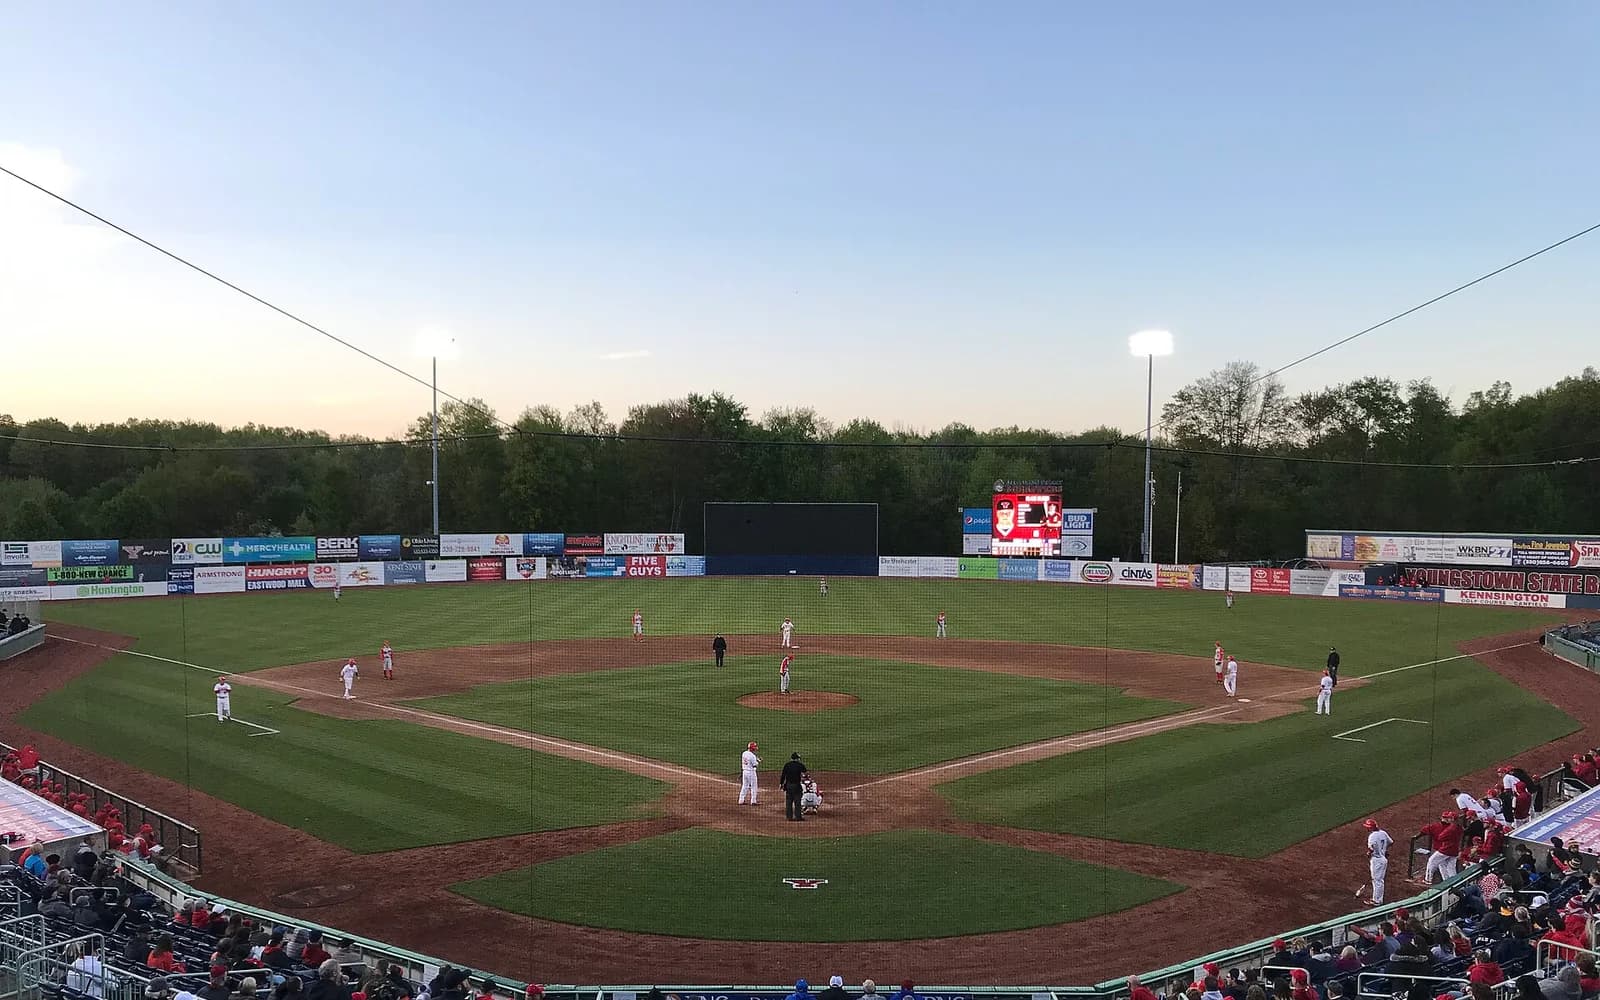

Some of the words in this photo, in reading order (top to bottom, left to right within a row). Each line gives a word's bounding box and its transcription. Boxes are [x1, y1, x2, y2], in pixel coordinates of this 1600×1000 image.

[1064, 521, 1090, 529] LIGHT
[246, 543, 311, 553] MERCYHEALTH
[317, 538, 359, 549] BERK
[631, 557, 658, 565] FIVE
[53, 571, 96, 579] 1-800-NEW
[97, 570, 127, 578] CHANCE
[195, 570, 242, 578] ARMSTRONG
[247, 567, 307, 577] HUNGRY?
[629, 566, 661, 576] GUYS
[247, 580, 287, 589] EASTWOOD
[288, 579, 306, 588] MALL
[1404, 567, 1525, 592] YOUNGSTOWN
[1528, 571, 1583, 594] STATE
[1585, 574, 1600, 594] B
[91, 584, 144, 596] Huntington
[1460, 591, 1549, 603] KENNSINGTON
